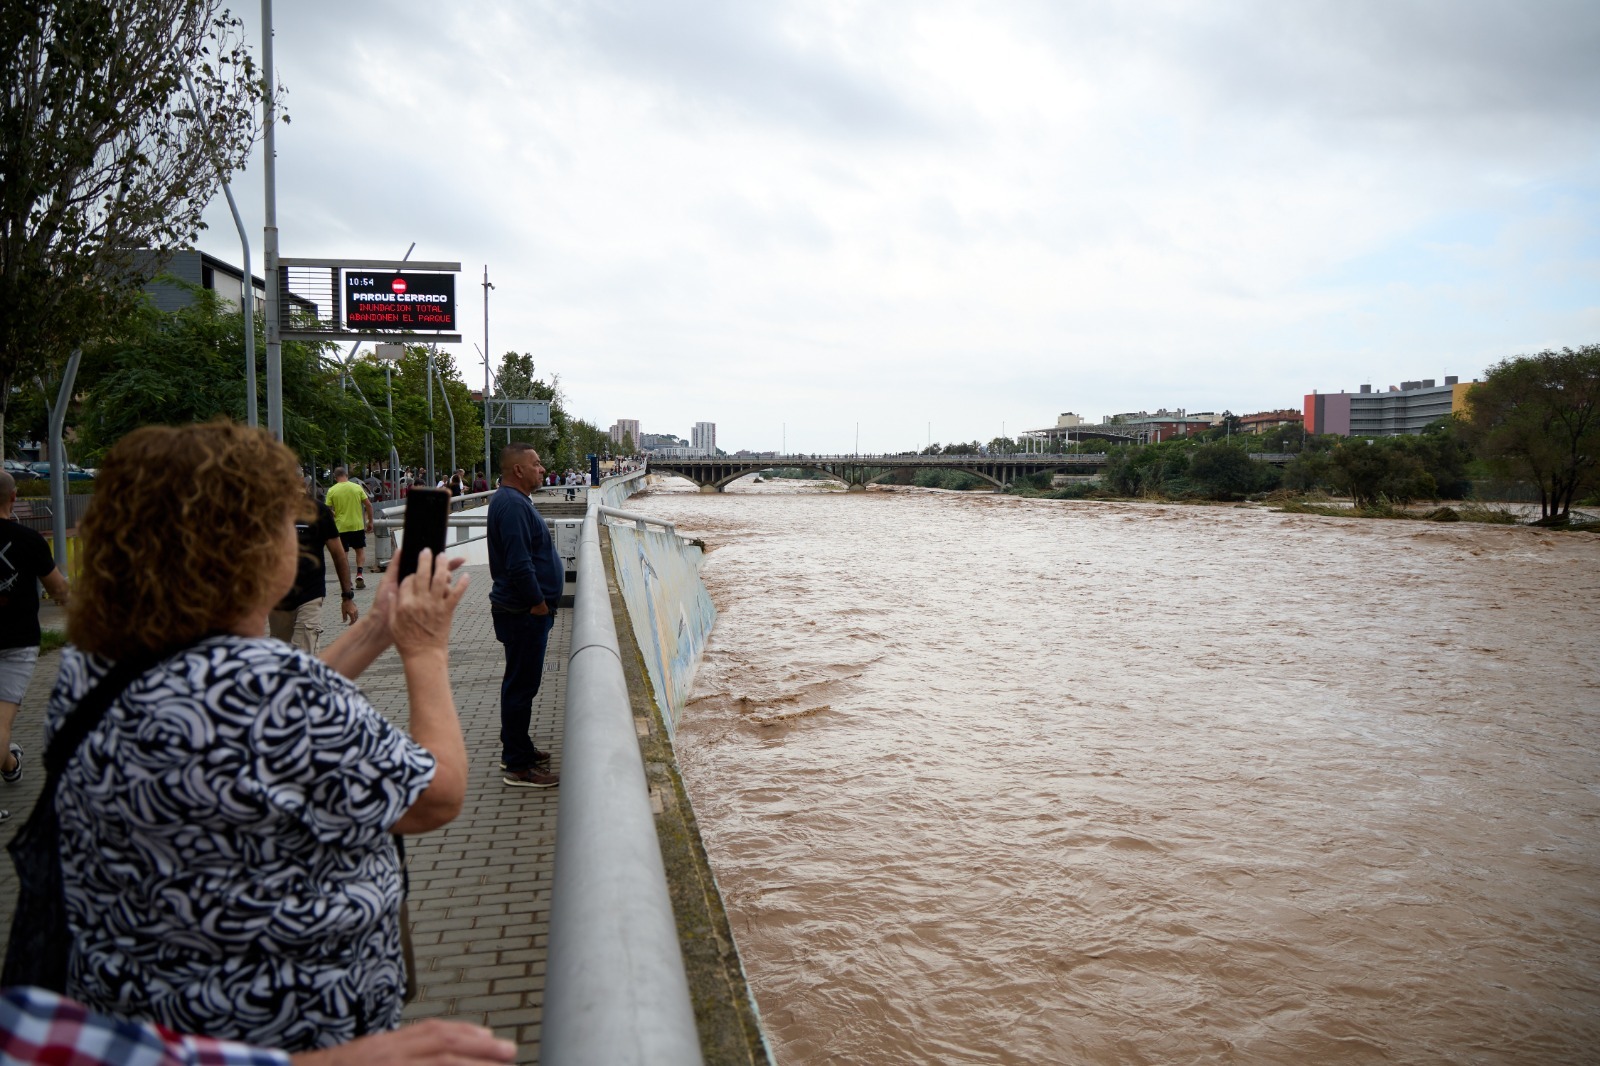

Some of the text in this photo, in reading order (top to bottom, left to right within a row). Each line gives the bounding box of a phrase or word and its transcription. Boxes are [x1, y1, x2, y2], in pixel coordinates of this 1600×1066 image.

[349, 278, 374, 286] 10:54
[353, 293, 447, 302] PARQUE CERRADO
[359, 304, 442, 313] INUNDACION TOTAL
[349, 313, 451, 323] ABANDONEN EL PARQUE
